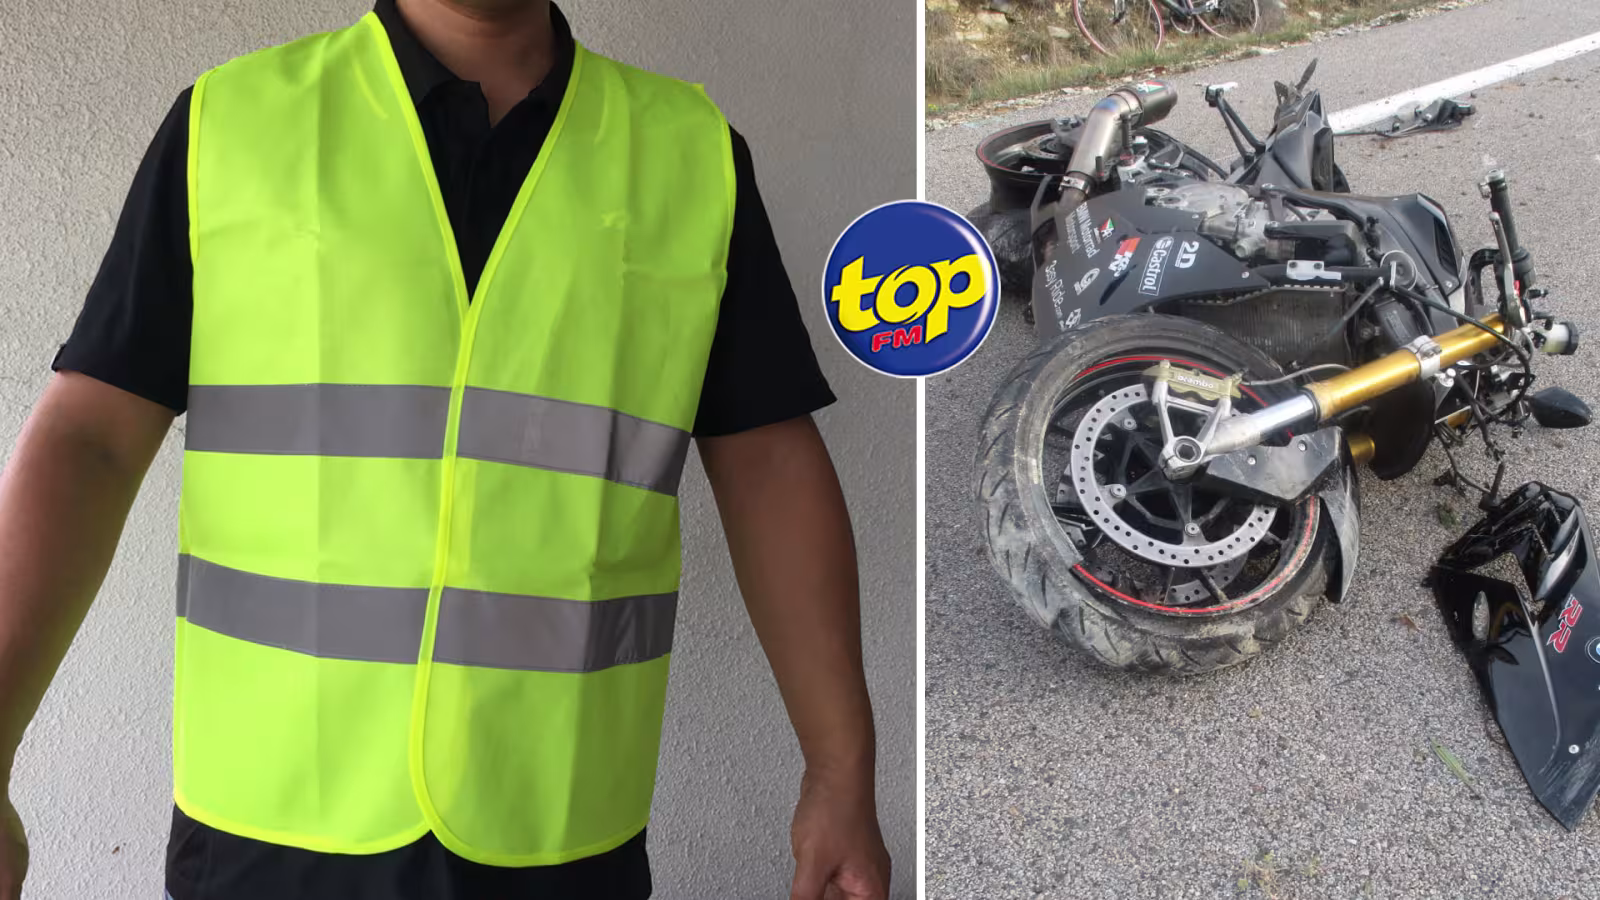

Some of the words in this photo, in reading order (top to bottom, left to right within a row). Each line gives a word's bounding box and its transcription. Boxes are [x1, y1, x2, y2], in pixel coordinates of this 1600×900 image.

[1080, 218, 1101, 259] Motorrad
[1180, 240, 1200, 269] 2D
[1142, 249, 1167, 291] Castrol
[1177, 375, 1214, 389] brembo
[1546, 594, 1583, 653] RR
